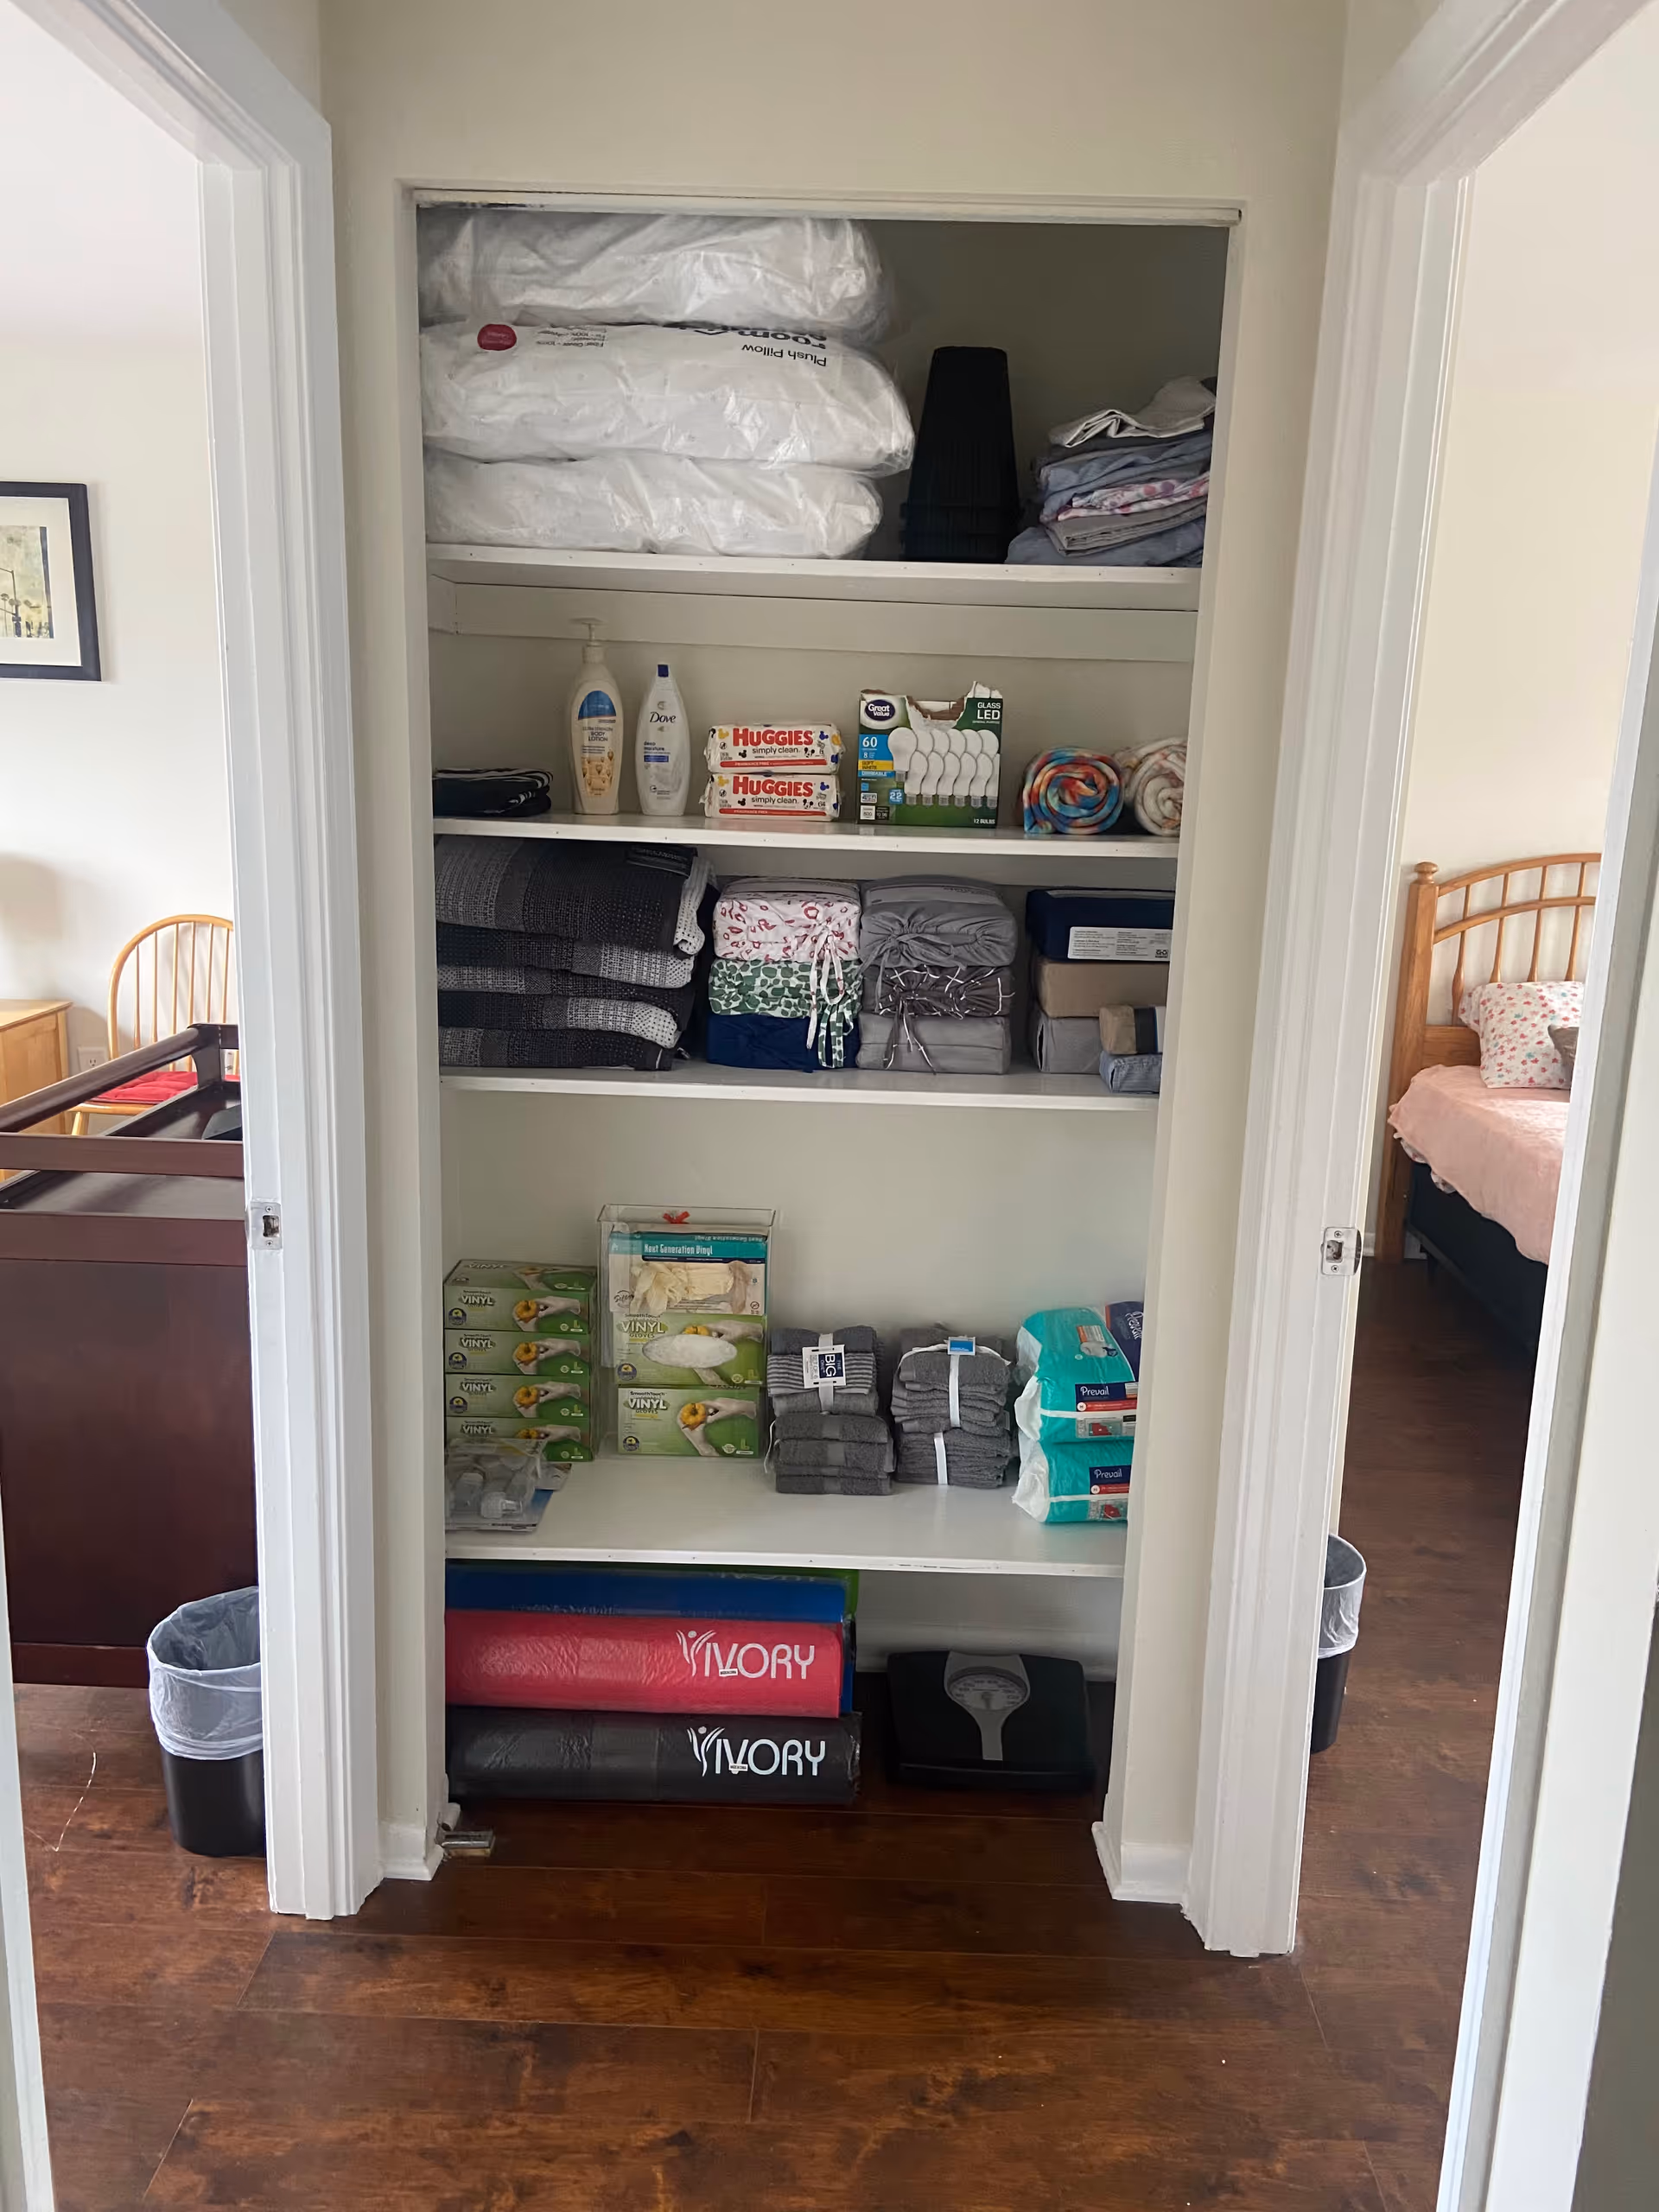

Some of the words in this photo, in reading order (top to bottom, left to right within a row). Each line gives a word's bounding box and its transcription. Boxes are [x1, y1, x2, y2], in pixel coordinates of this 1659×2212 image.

[741, 344, 784, 359] Pillow
[788, 350, 827, 366] Plush
[868, 703, 890, 712] Great
[650, 711, 676, 723] Dove
[977, 709, 1001, 720] LED
[862, 736, 878, 747] 60
[752, 746, 777, 757] simply
[752, 796, 776, 804] simply
[889, 791, 902, 800] 22
[644, 1244, 658, 1253] Next
[660, 1244, 695, 1255] Generation
[696, 1245, 713, 1255] Vinyl
[461, 1295, 493, 1306] VINYL
[622, 1321, 664, 1333] VINYL
[461, 1338, 493, 1349] VINYL
[824, 1354, 836, 1377] BIG
[461, 1382, 493, 1392] VINYL
[1080, 1385, 1109, 1396] Prevail
[628, 1398, 667, 1410] VINYL
[462, 1425, 493, 1434] VINYL
[1094, 1468, 1122, 1479] Prevail
